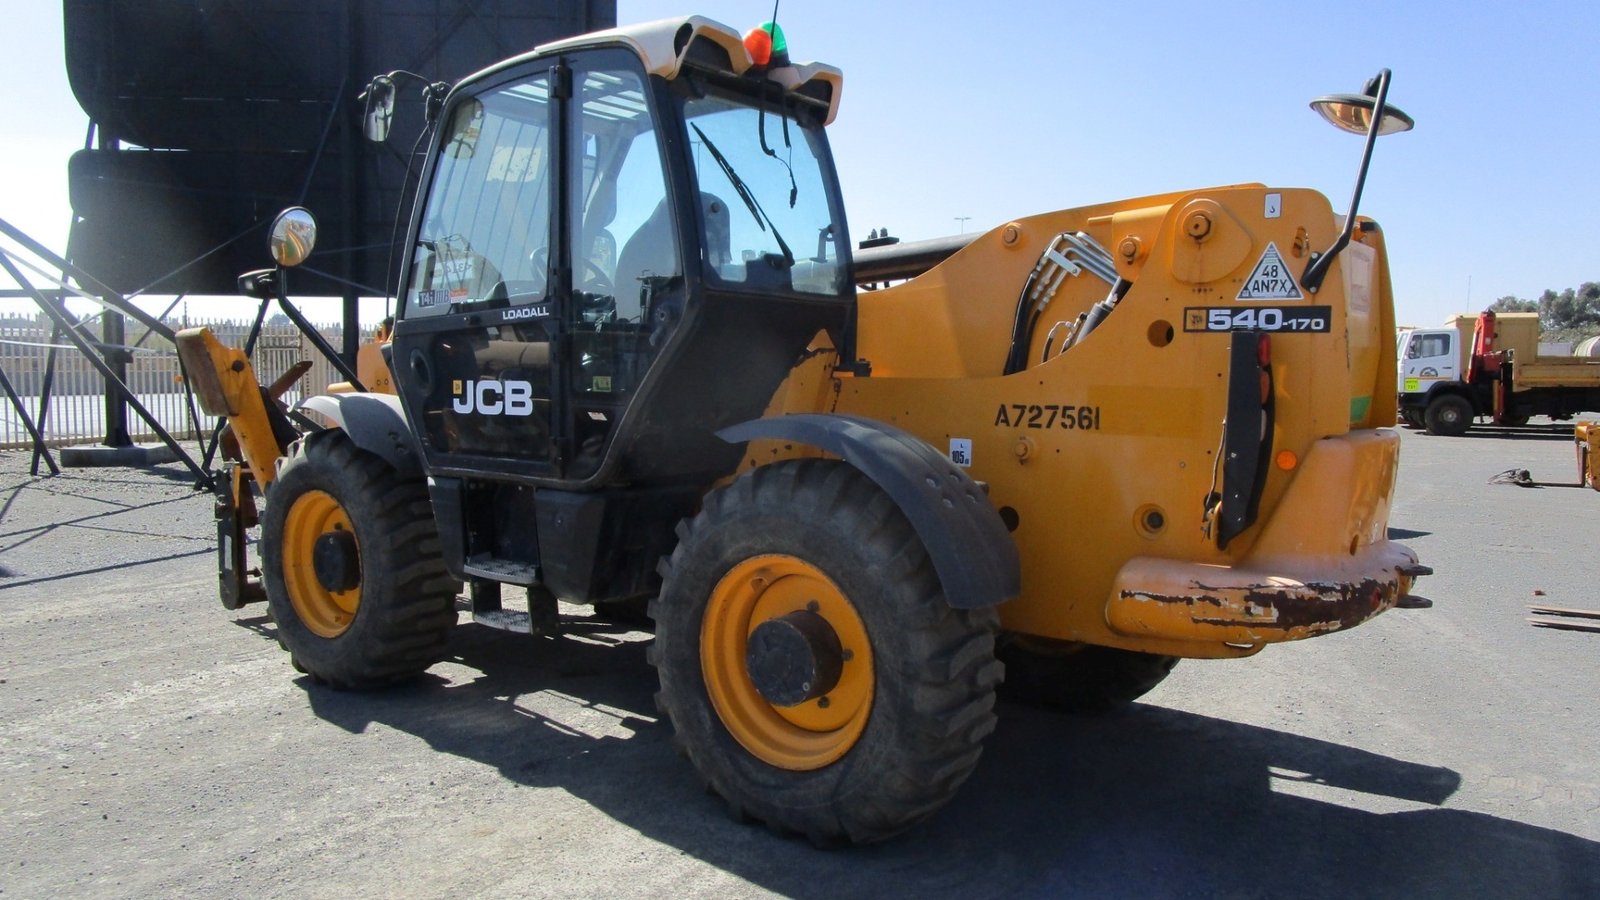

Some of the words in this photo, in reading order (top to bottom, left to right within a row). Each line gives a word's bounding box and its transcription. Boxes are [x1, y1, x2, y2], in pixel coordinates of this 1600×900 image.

[1262, 265, 1278, 278] 48
[1252, 279, 1287, 293] AN7X
[502, 306, 550, 320] LOADALL
[1208, 308, 1325, 331] 540-170
[453, 380, 533, 416] JCB
[952, 450, 965, 464] 105
